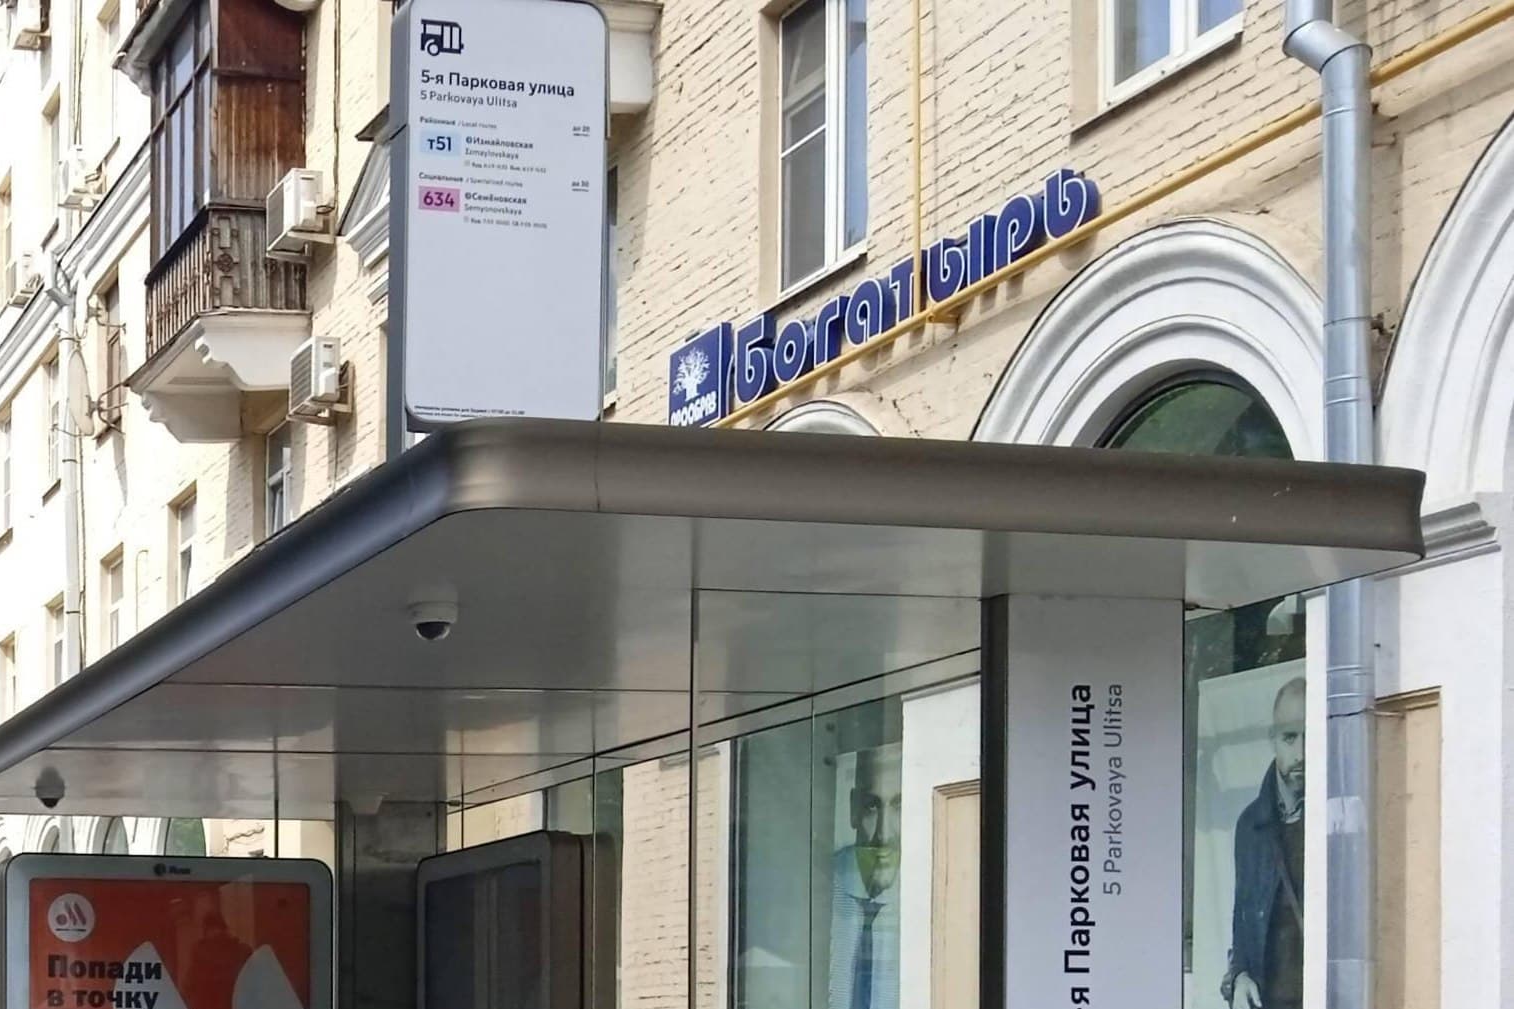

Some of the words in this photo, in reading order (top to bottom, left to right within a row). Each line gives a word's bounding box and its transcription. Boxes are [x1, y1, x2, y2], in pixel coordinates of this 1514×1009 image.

[421, 69, 444, 85] 5-я
[449, 72, 525, 95] Парковая
[529, 84, 575, 98] улица
[420, 90, 428, 100] 5
[429, 90, 484, 107] Parkovaya
[486, 95, 517, 109] Ulitsa
[423, 191, 455, 208] 634
[1102, 683, 1123, 749] Ulitsa
[1070, 683, 1097, 791] улица
[1102, 755, 1127, 875] Parkovaya
[1063, 803, 1097, 974] Парковая
[1102, 880, 1122, 896] 5
[47, 954, 162, 984] Попади
[47, 990, 64, 1008] в
